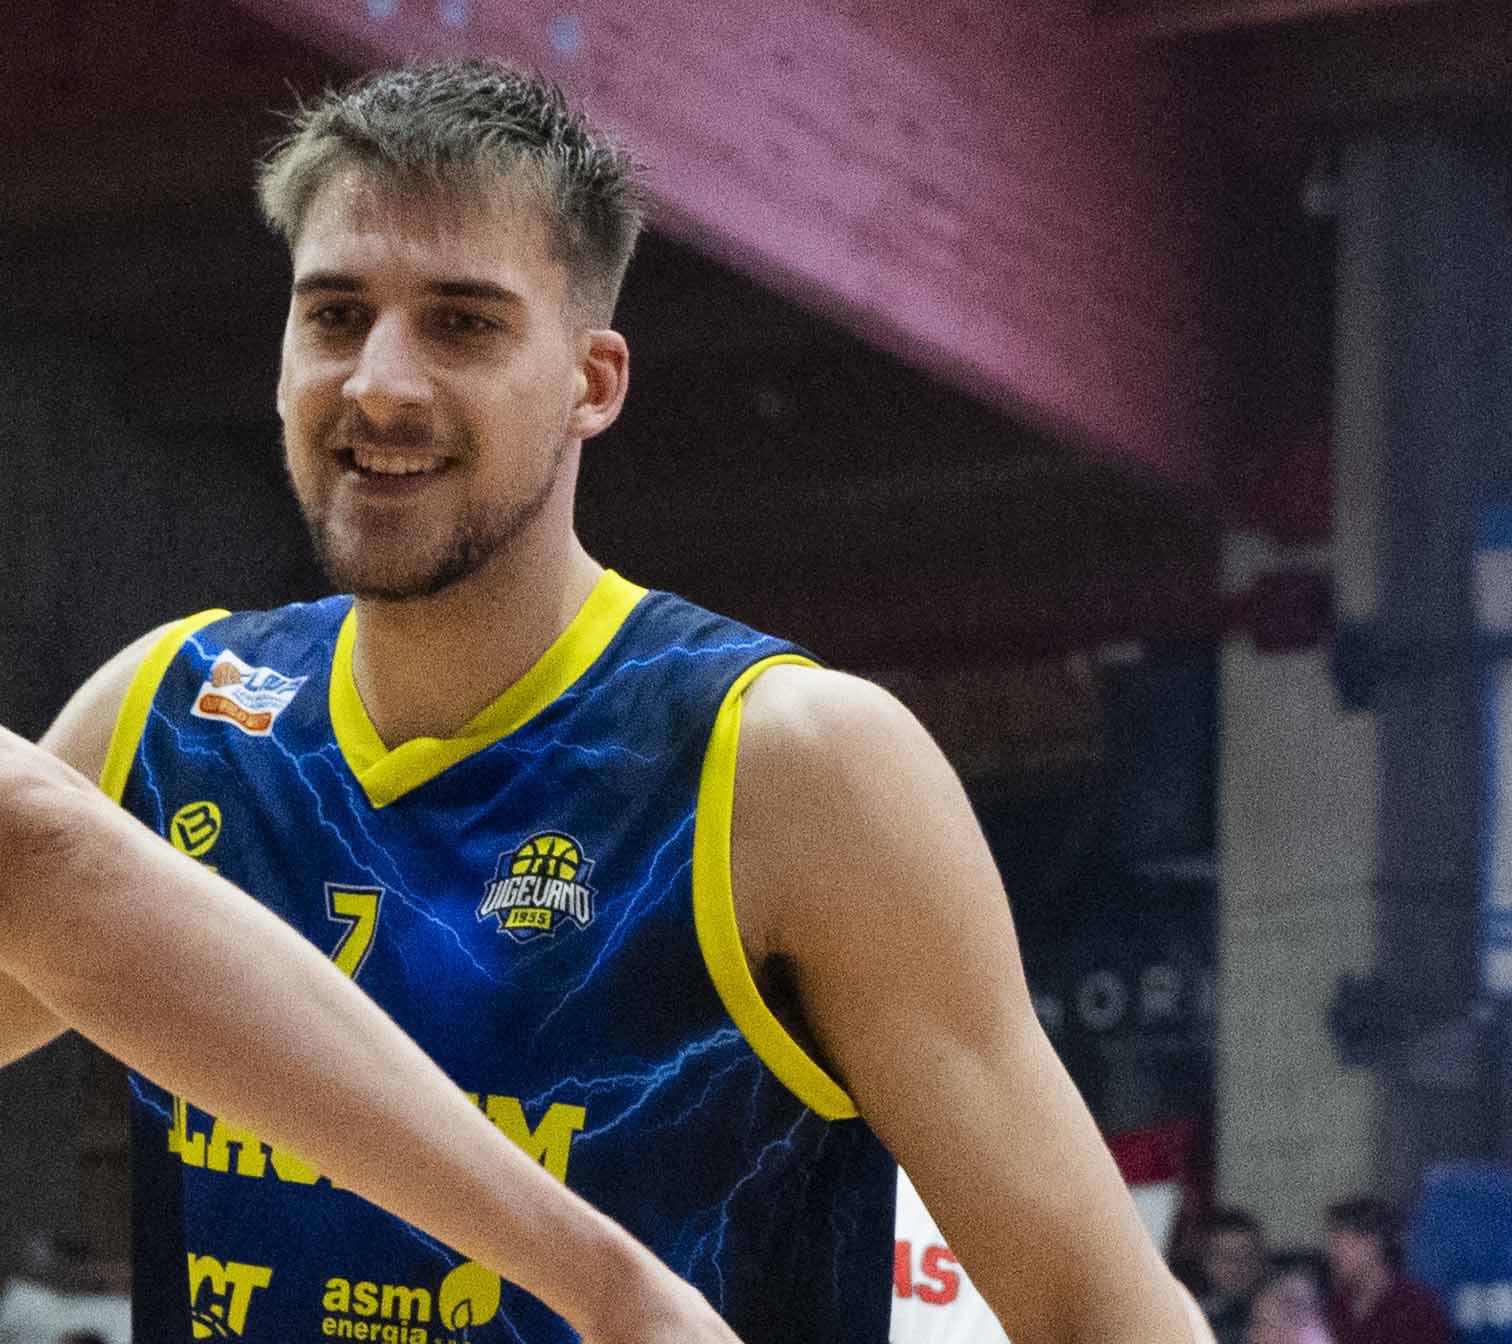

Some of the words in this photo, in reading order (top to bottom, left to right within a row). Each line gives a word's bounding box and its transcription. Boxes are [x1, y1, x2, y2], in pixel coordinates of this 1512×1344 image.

[480, 875, 591, 924] VIGEVANO
[510, 911, 548, 925] 1955
[324, 881, 386, 982] 7
[323, 1277, 432, 1322] asm
